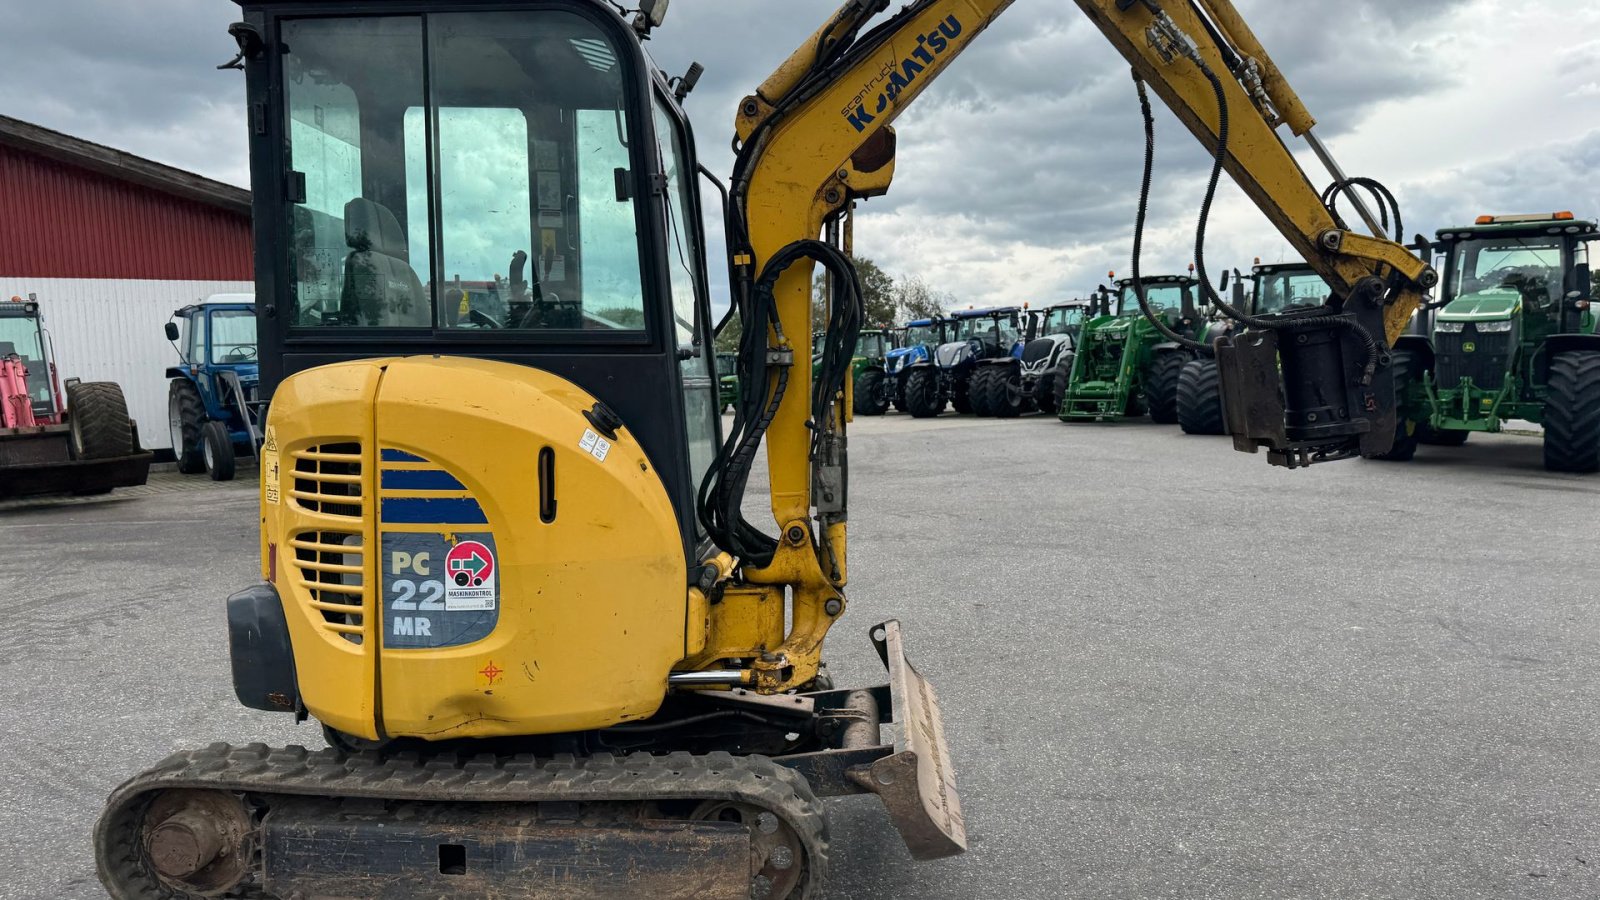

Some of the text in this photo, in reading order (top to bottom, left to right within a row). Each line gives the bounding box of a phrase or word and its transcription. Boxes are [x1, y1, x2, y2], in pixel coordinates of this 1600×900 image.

[841, 59, 897, 117] scantruck
[392, 551, 430, 576] PC
[391, 579, 445, 611] 22
[393, 616, 432, 636] MR
